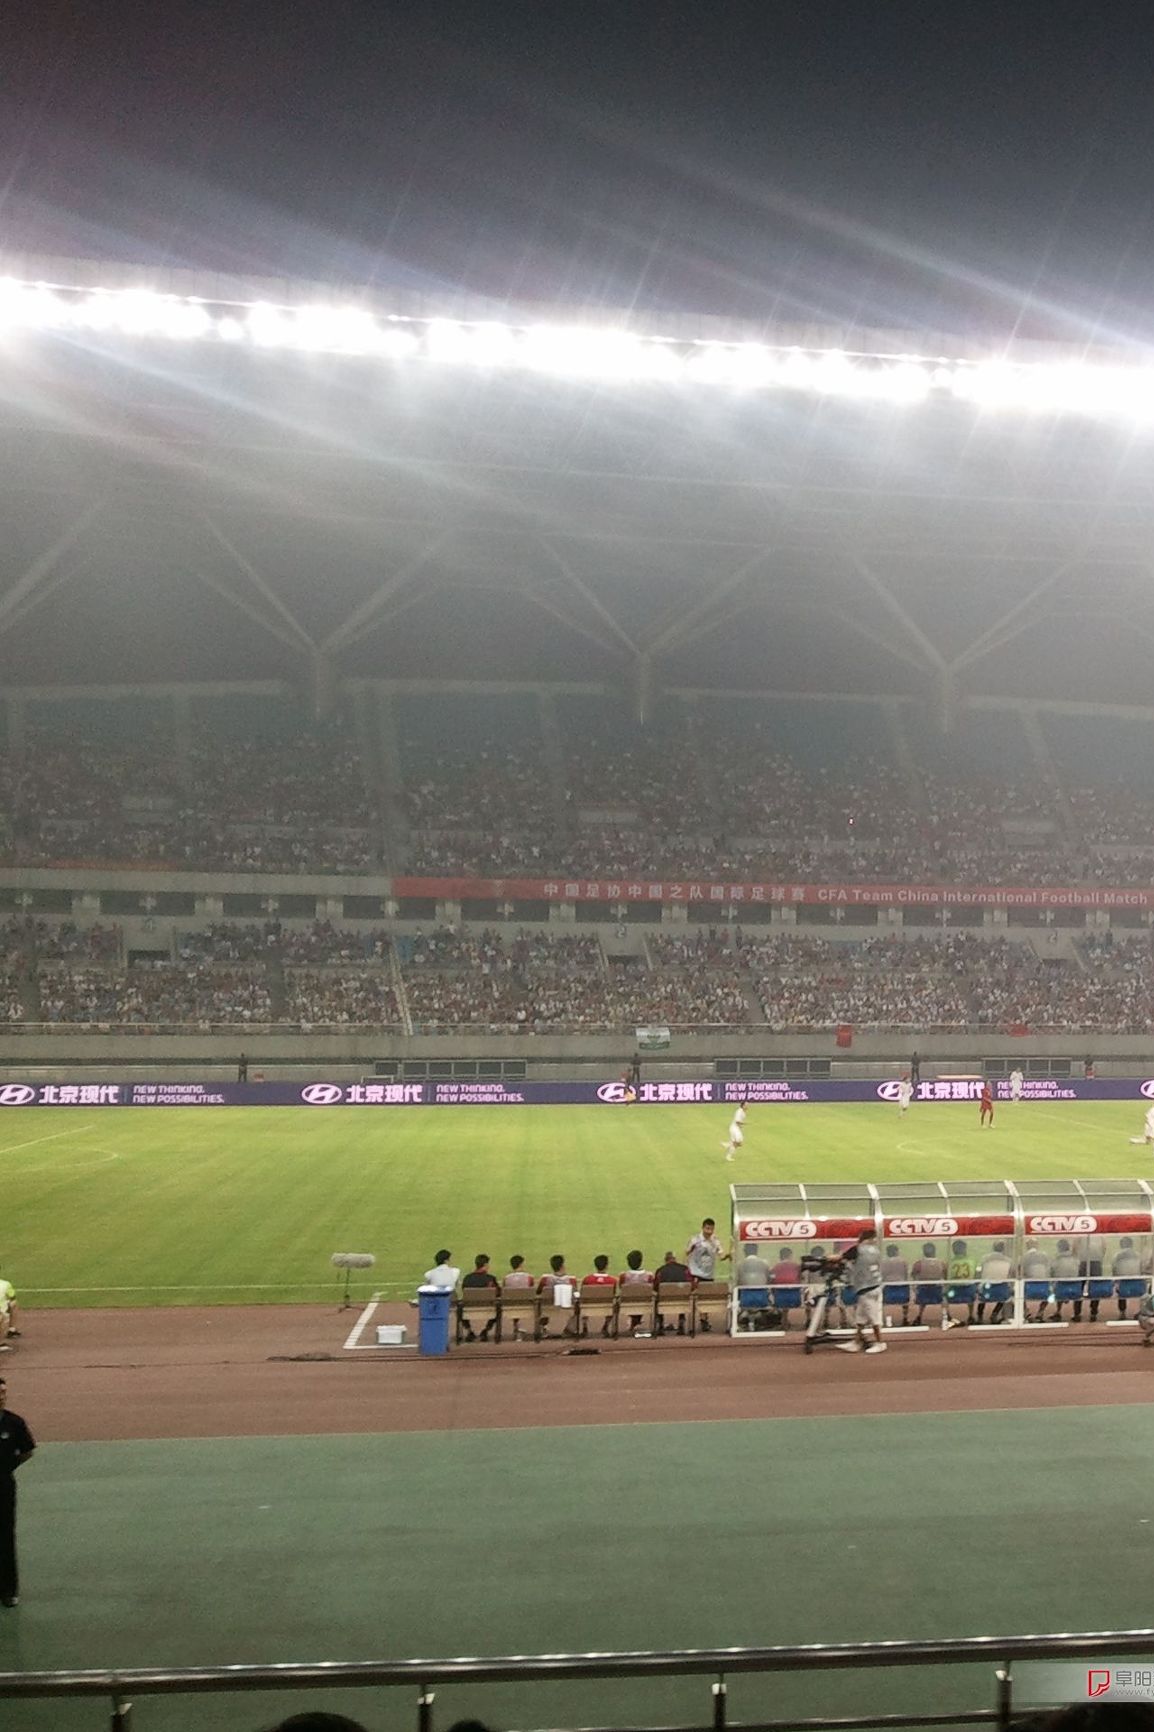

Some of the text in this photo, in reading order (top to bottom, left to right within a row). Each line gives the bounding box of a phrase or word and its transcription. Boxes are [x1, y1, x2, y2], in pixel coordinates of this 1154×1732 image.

[818, 889, 1148, 905] CFA Team China International Football Match
[39, 1085, 119, 1104] 北京现代
[346, 1084, 423, 1103] 北京现代
[640, 1083, 712, 1101] 北京现代
[917, 1082, 985, 1099] 北京现代
[952, 1262, 970, 1279] 23
